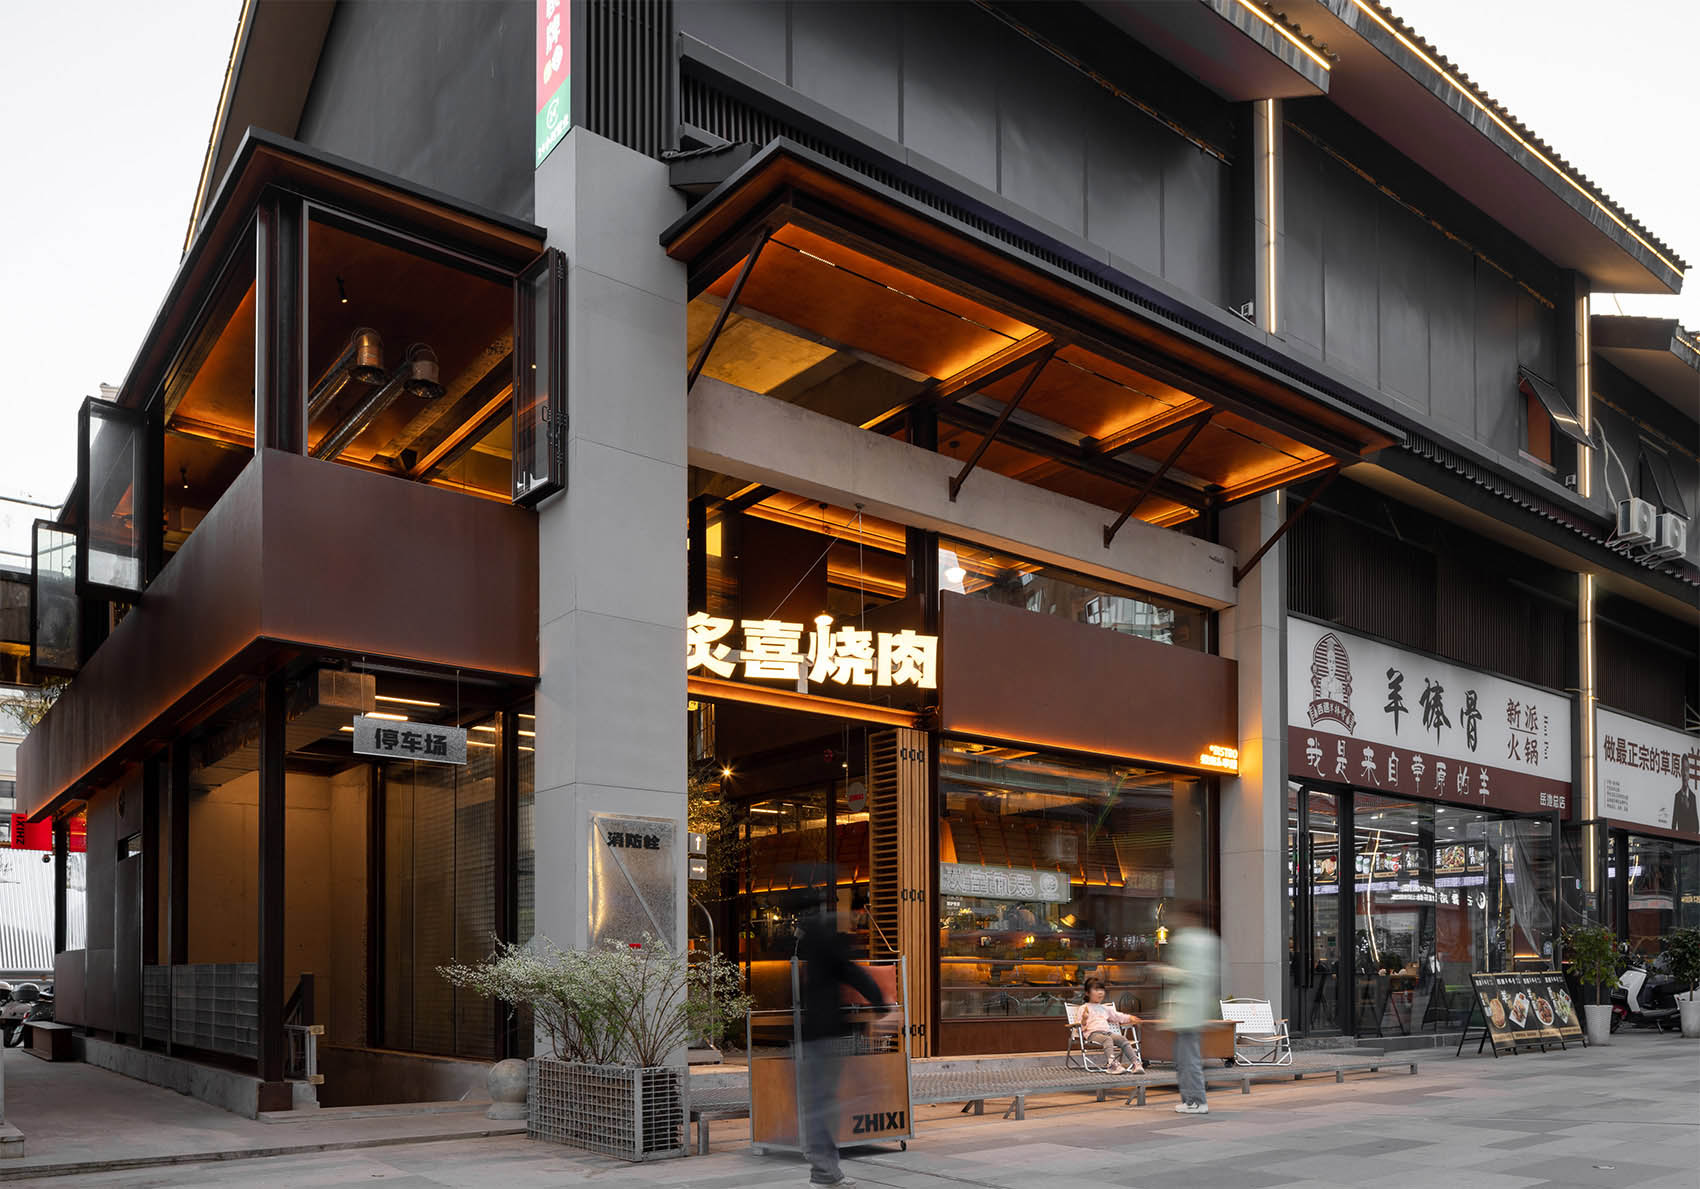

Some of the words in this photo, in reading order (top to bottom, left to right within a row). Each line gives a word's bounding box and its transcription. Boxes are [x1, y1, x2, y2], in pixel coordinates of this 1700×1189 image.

[687, 611, 938, 689] 炙喜烧肉
[1384, 667, 1482, 752] 羊棒骨
[1506, 698, 1538, 731] 新派
[375, 727, 447, 756] 停车场
[1507, 733, 1538, 766] 火锅
[1306, 736, 1490, 805] 我是来自草原的羊
[16, 816, 25, 845] ZHIXI
[607, 831, 660, 850] 消防栓
[852, 1111, 905, 1134] ZHIXI
